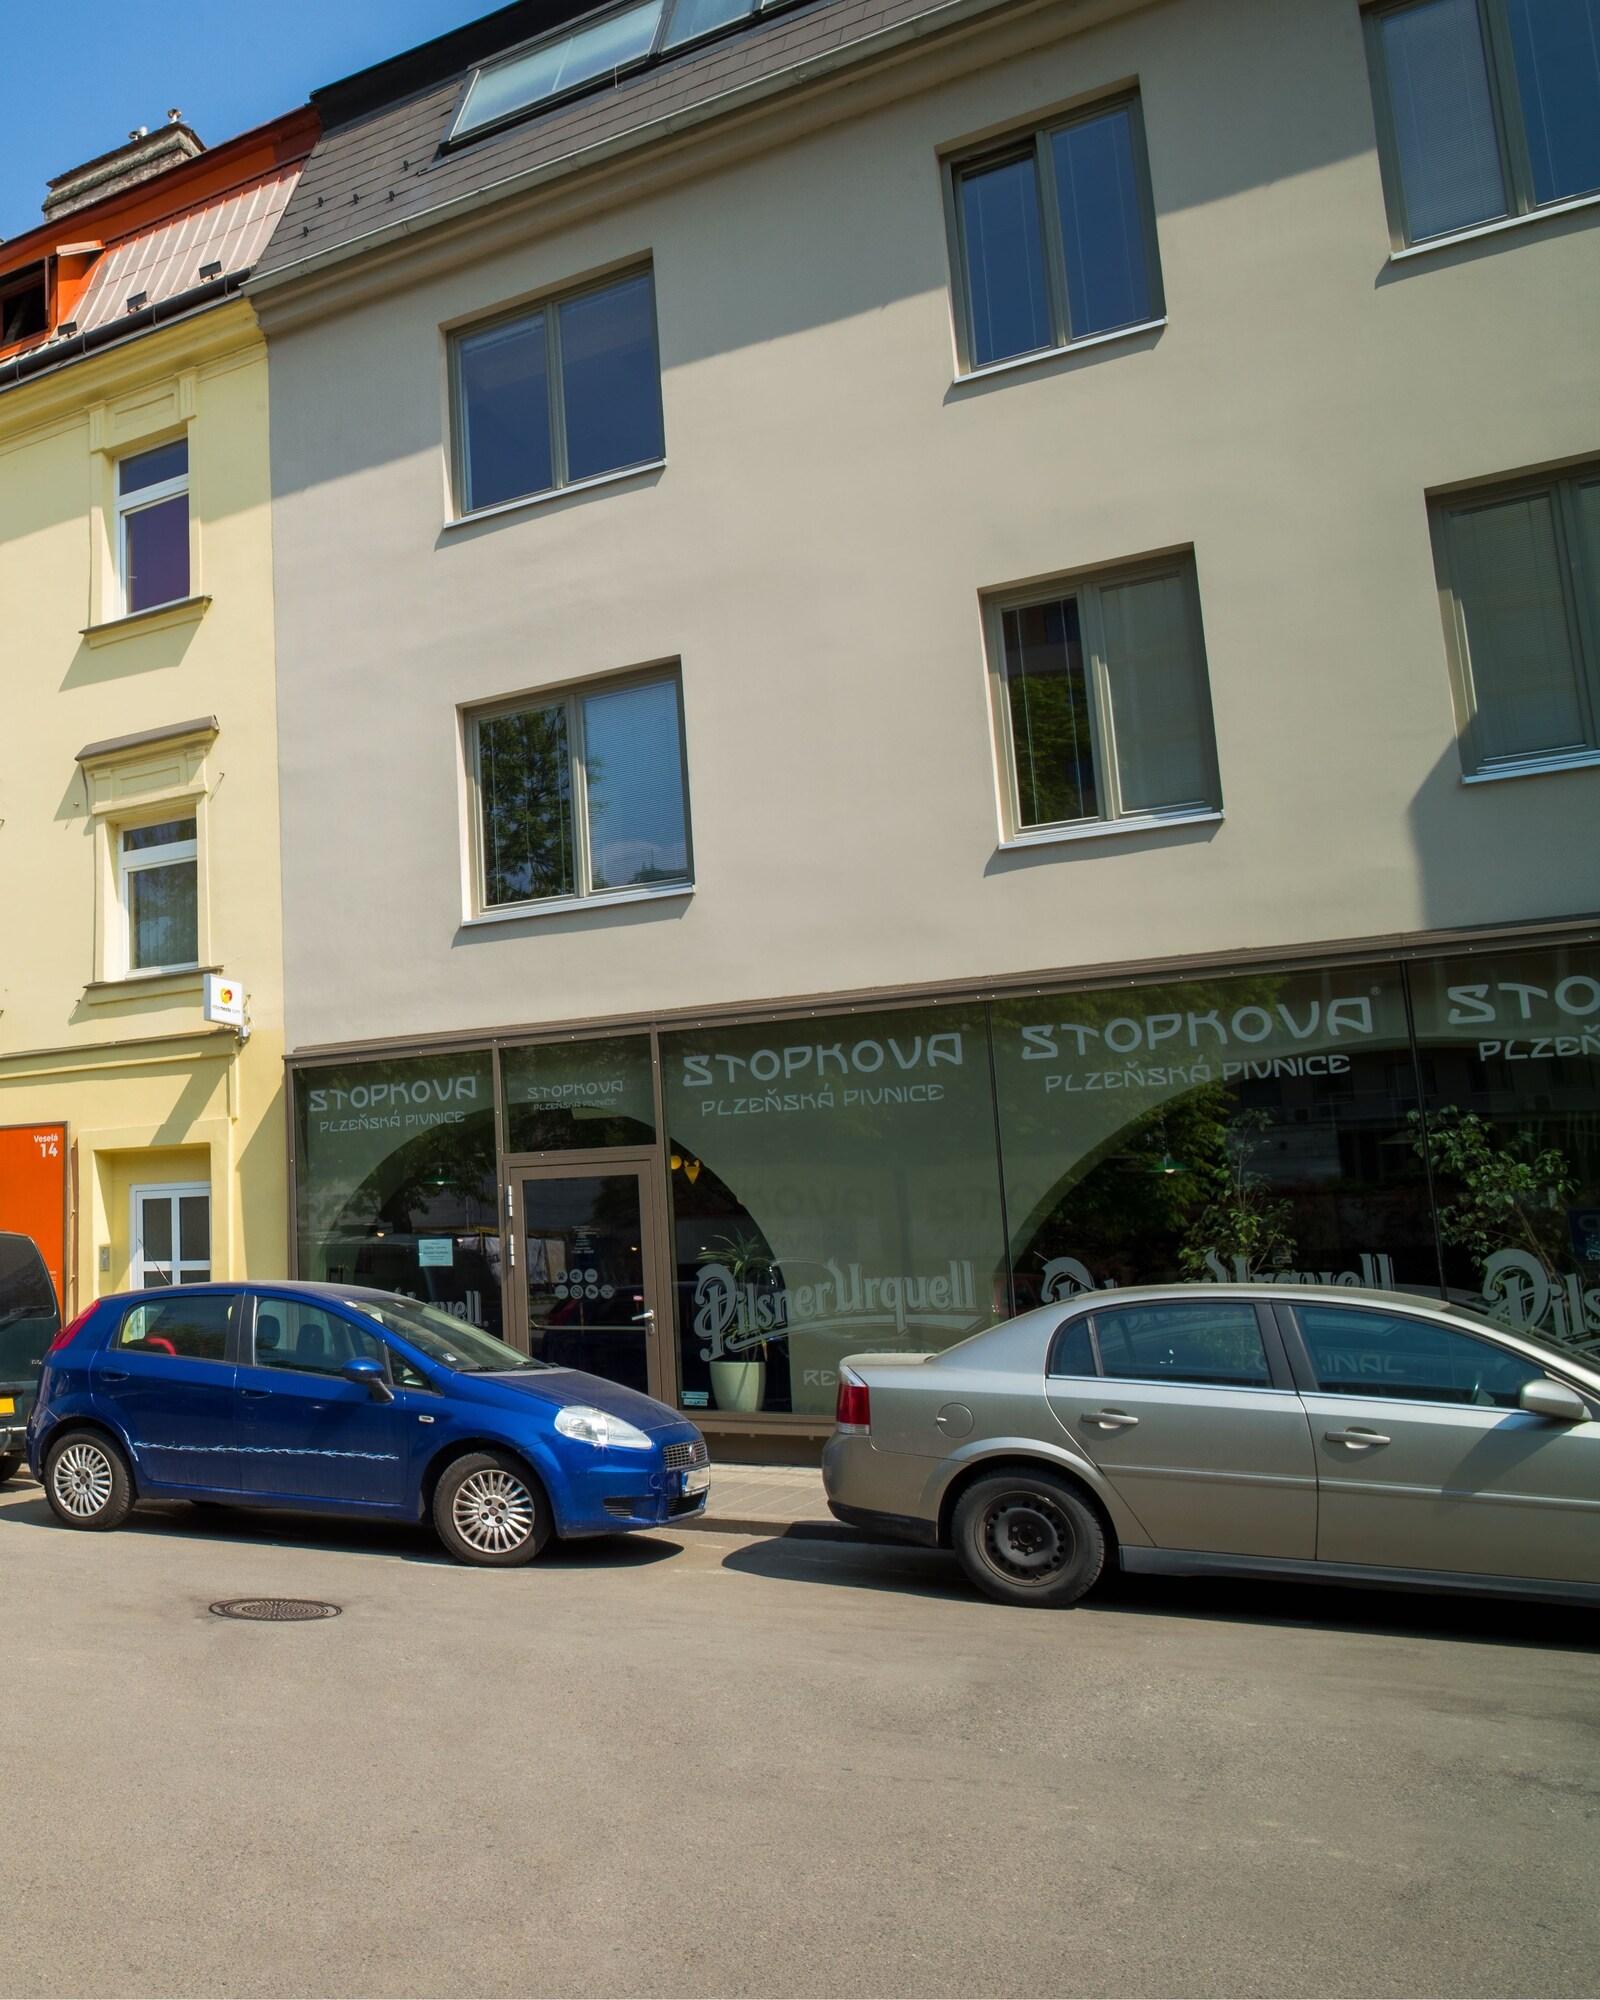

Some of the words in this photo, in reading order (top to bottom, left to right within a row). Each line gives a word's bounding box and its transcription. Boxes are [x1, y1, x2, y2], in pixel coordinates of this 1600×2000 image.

[1021, 996, 1374, 1060] STOPKOVA
[682, 1032, 963, 1087] STOPKOVA
[1044, 1055, 1212, 1093] PLZEŇSKÁ
[1222, 1054, 1351, 1081] PIVNICE
[308, 1075, 477, 1112] STOPKOVA
[527, 1079, 624, 1099] STOPKOVA
[701, 1083, 835, 1117] PLZEŇSKÁ
[843, 1084, 945, 1107] PIVNICE
[319, 1110, 401, 1133] PLZEŇSKÁ
[405, 1111, 465, 1127] PIVNICE
[40, 1143, 58, 1158] 14
[693, 1263, 833, 1362] Pilsner
[825, 1257, 978, 1334] Urquell
